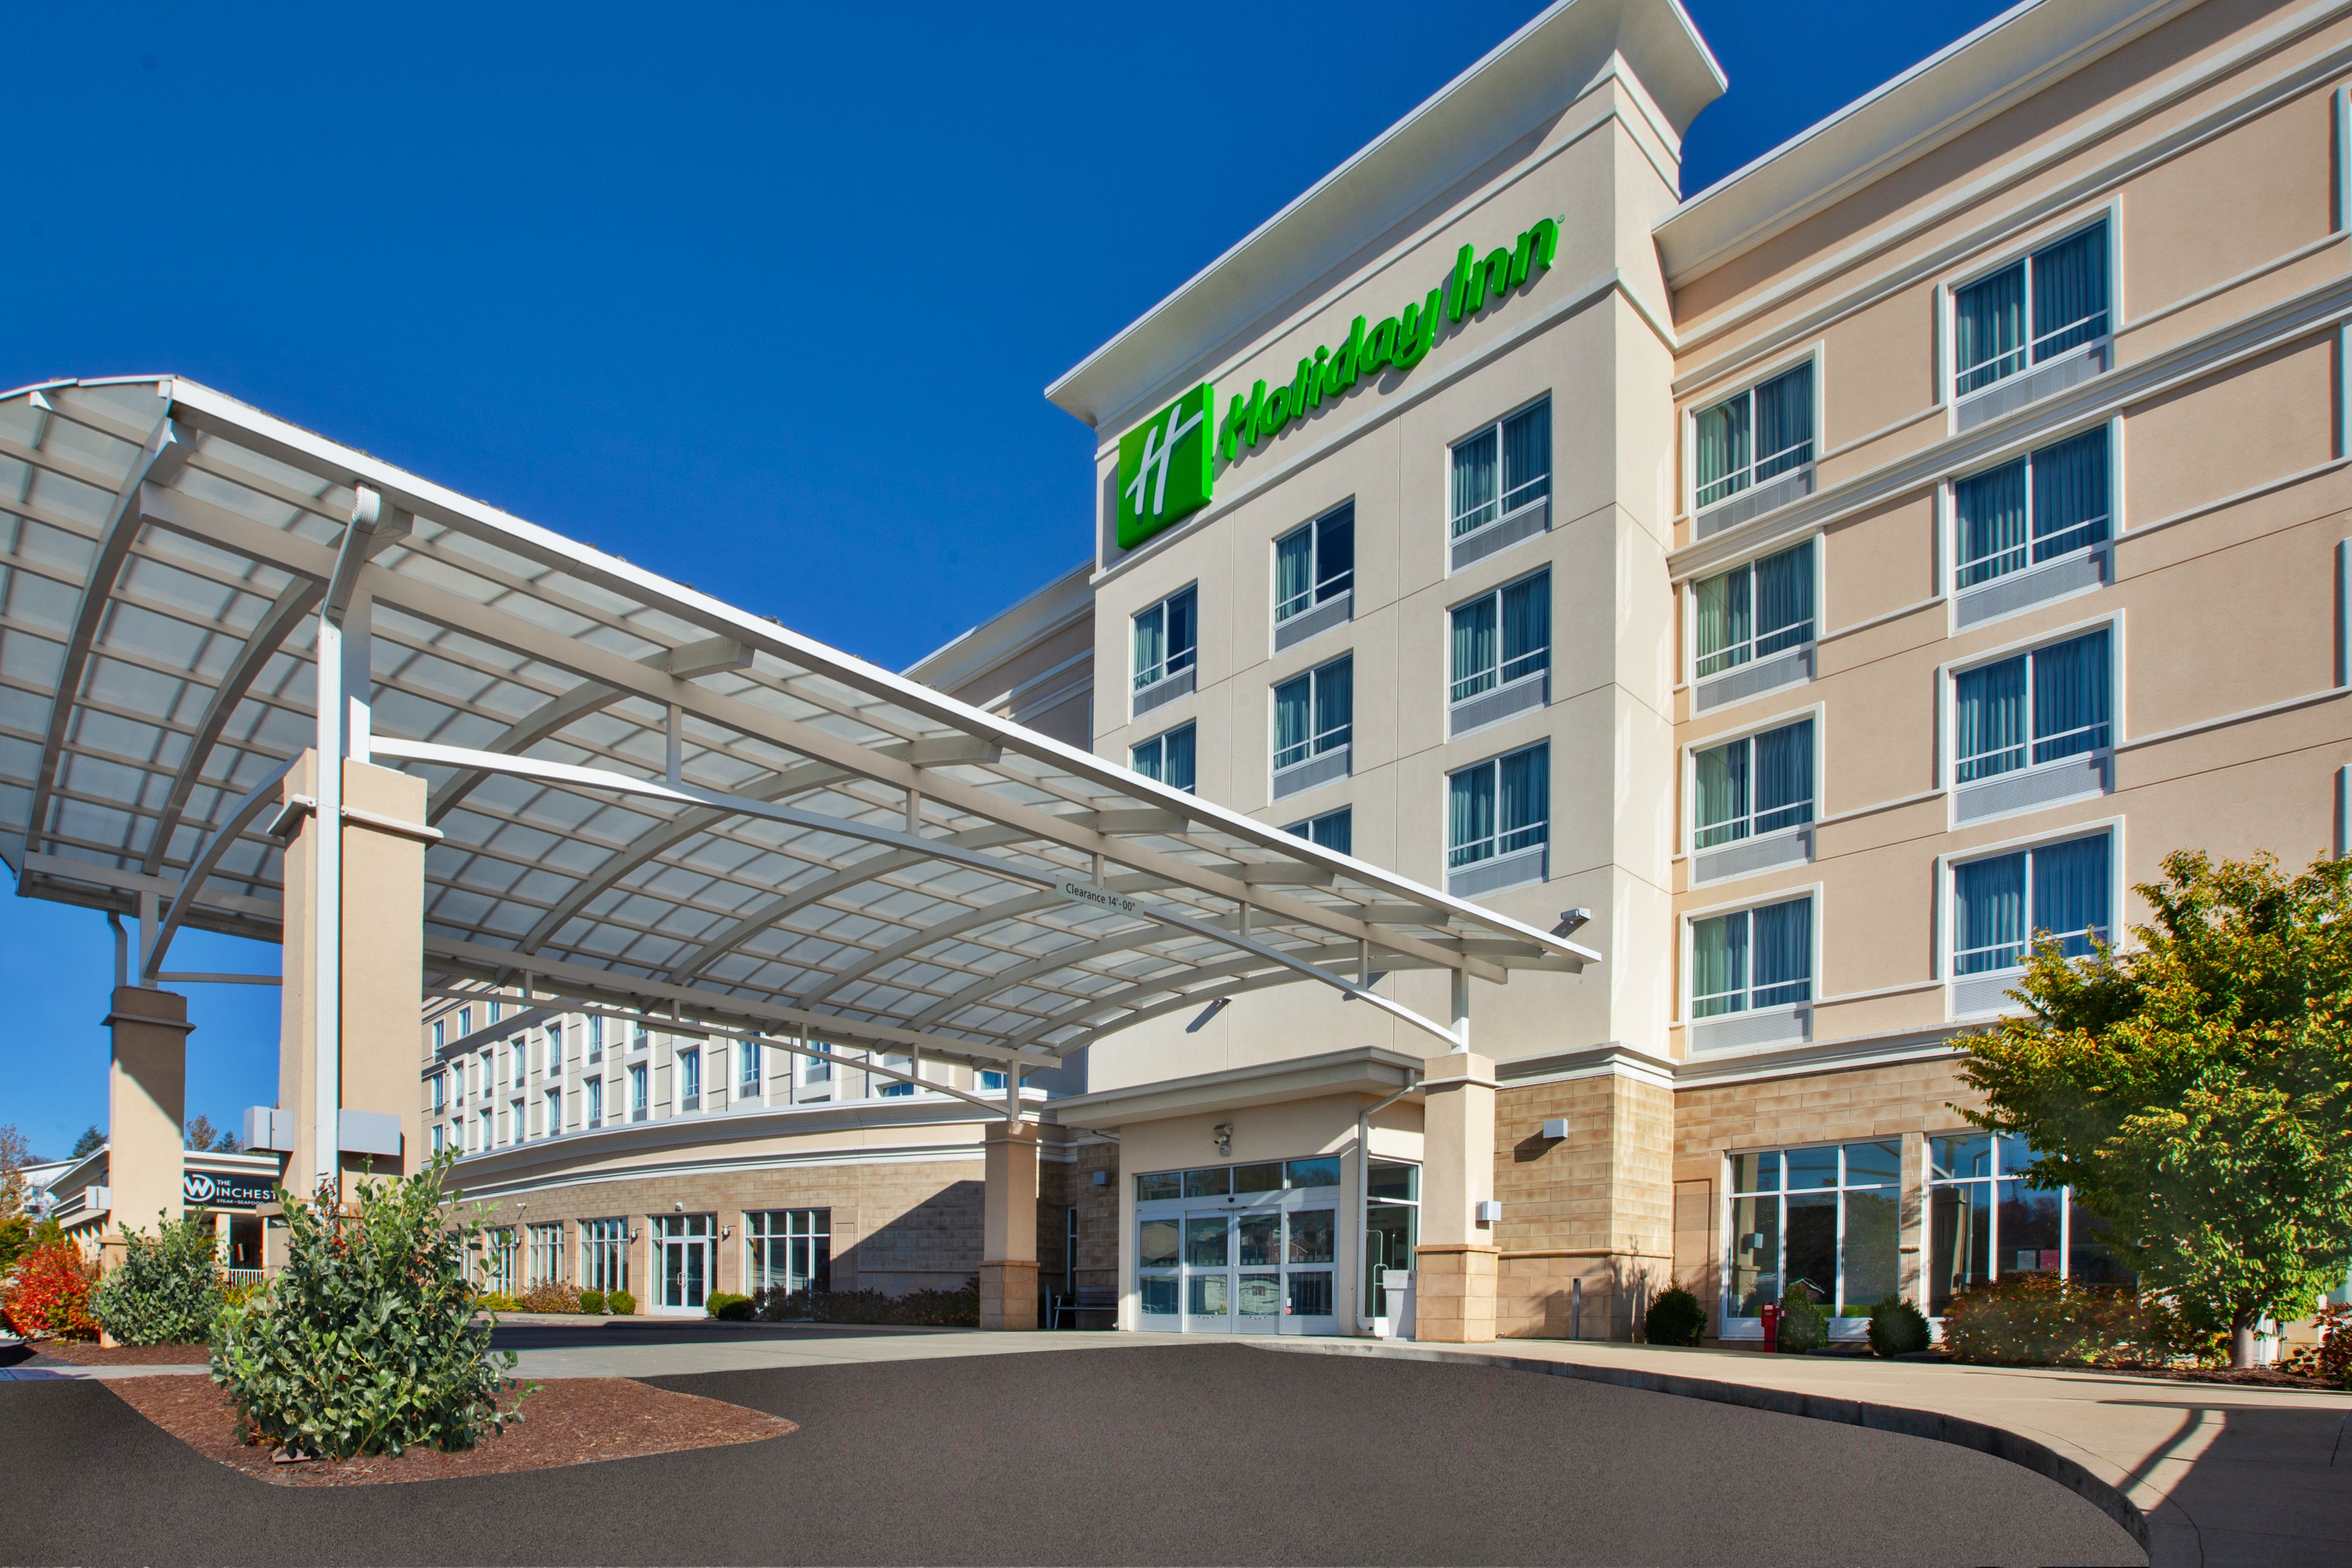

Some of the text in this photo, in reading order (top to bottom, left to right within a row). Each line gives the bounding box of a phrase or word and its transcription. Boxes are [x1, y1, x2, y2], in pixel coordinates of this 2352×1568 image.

[1220, 217, 1559, 461] Holiday Inn
[1066, 883, 1106, 904] Clearance
